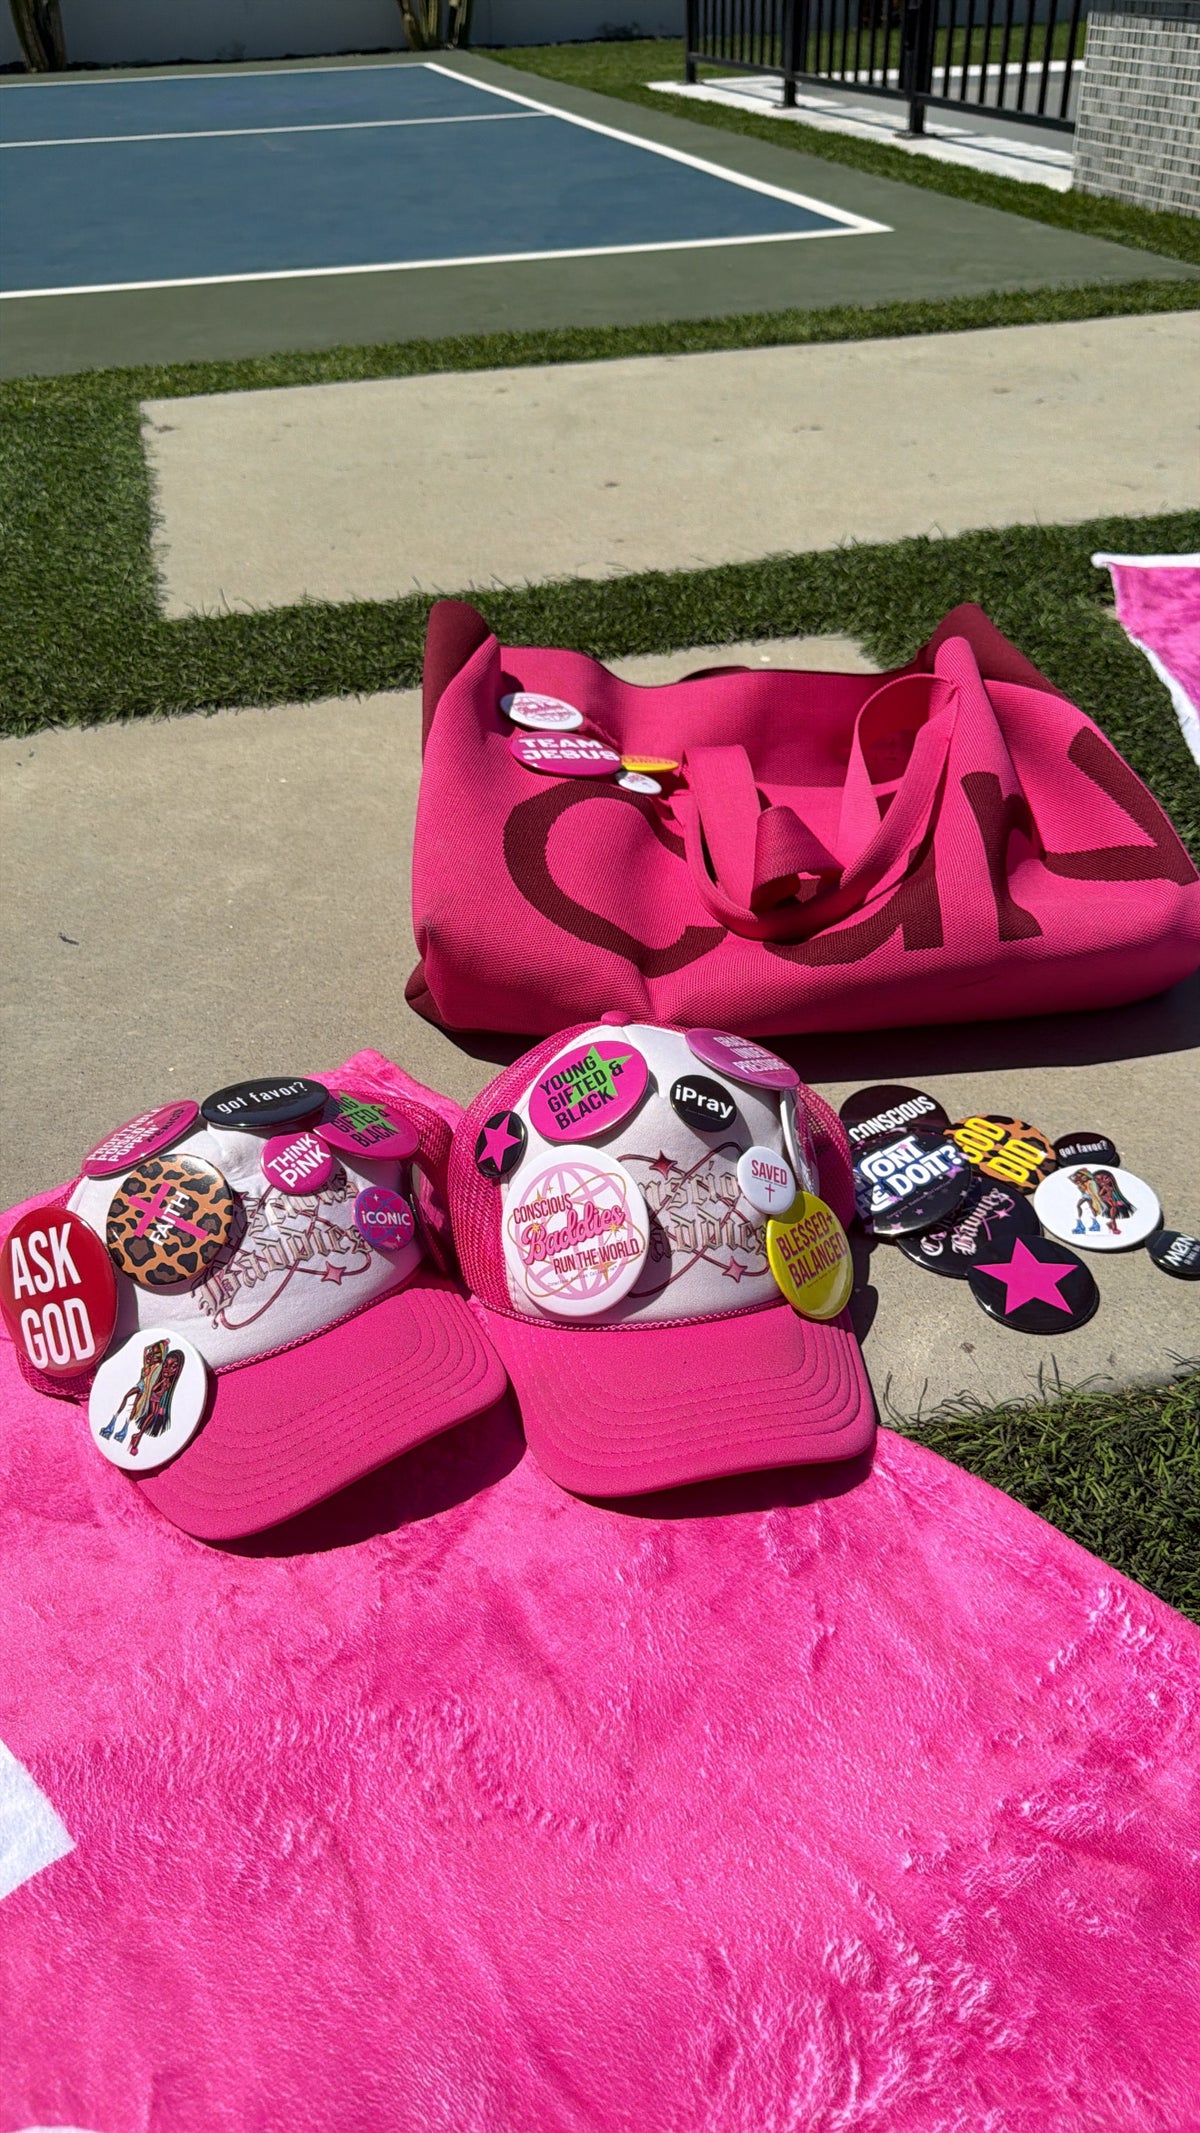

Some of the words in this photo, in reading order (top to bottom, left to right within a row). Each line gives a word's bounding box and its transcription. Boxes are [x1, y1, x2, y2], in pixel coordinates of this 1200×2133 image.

[519, 738, 603, 749] TEAM
[521, 750, 620, 761] JESUS
[539, 1056, 598, 1097] YOUNG
[547, 1074, 608, 1113] GIFTED
[607, 1061, 624, 1077] &
[217, 1095, 249, 1115] got
[250, 1081, 308, 1103] favor?
[555, 1086, 619, 1131] BLACK
[675, 1085, 733, 1119] iPray
[331, 1108, 379, 1134] GIFTED
[372, 1105, 390, 1118] &
[350, 1123, 399, 1148] BLACK
[848, 1095, 936, 1142] CONSCIOUS
[97, 1127, 145, 1161] POISED
[987, 1138, 1046, 1184] DID
[1059, 1145, 1075, 1158] got
[1078, 1139, 1107, 1154] favor?
[751, 1159, 788, 1185] SAVED
[149, 1190, 190, 1248] FAITH
[361, 1209, 411, 1226] iCONIC
[513, 1193, 573, 1225] CONSCIOUS
[521, 1201, 626, 1266] Baddies
[10, 1222, 81, 1299] ASK
[553, 1254, 577, 1275] RUN
[577, 1248, 599, 1270] THE
[598, 1238, 644, 1263] WORLD.
[788, 1231, 847, 1288] BALANCED
[191, 1225, 374, 1331] Baddies
[21, 1299, 96, 1370] GOD
